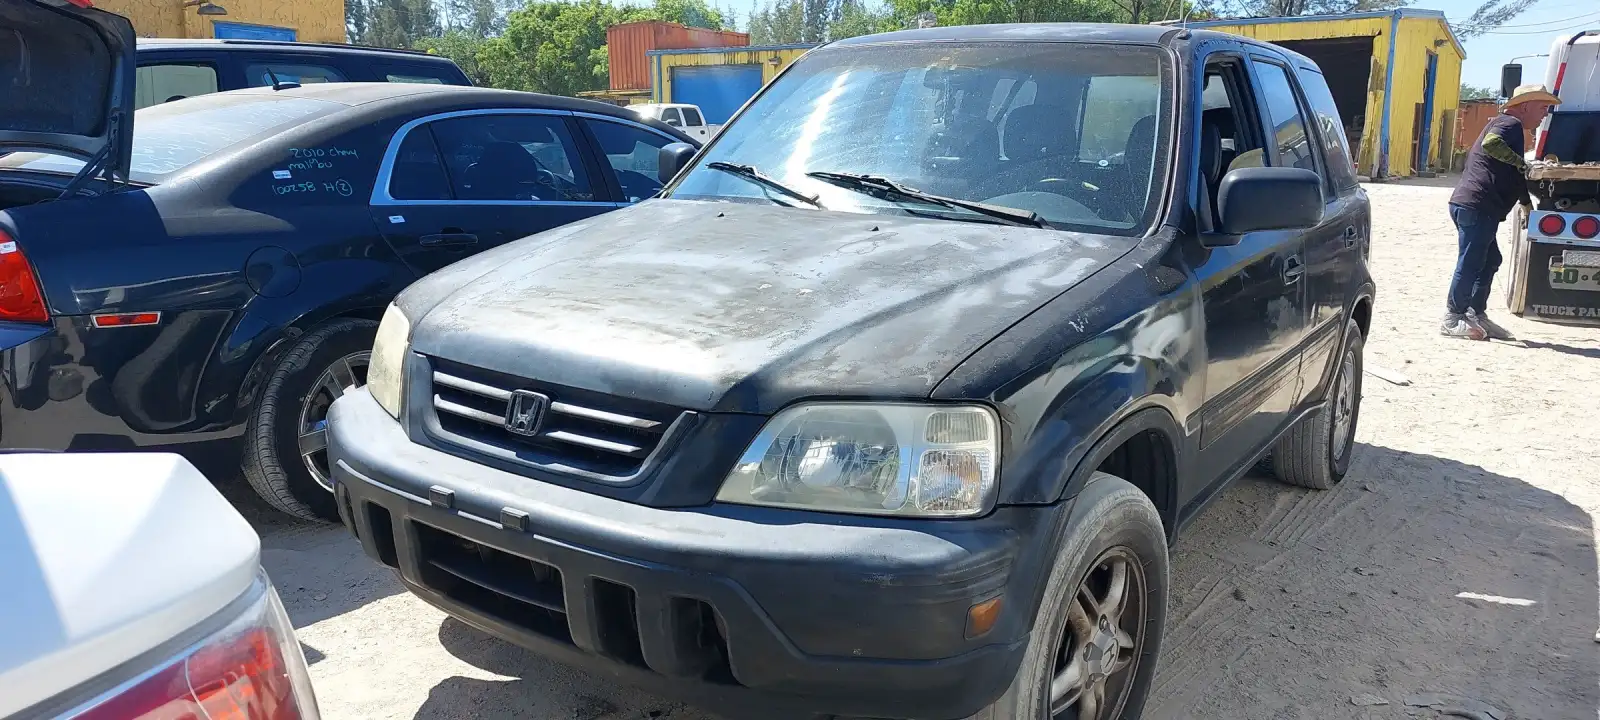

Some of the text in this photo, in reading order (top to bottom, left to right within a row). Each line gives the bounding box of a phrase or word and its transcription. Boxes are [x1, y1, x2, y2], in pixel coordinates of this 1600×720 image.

[289, 148, 325, 158] 2010
[272, 181, 316, 195] 100258
[1532, 304, 1600, 318] TRUCK PA
